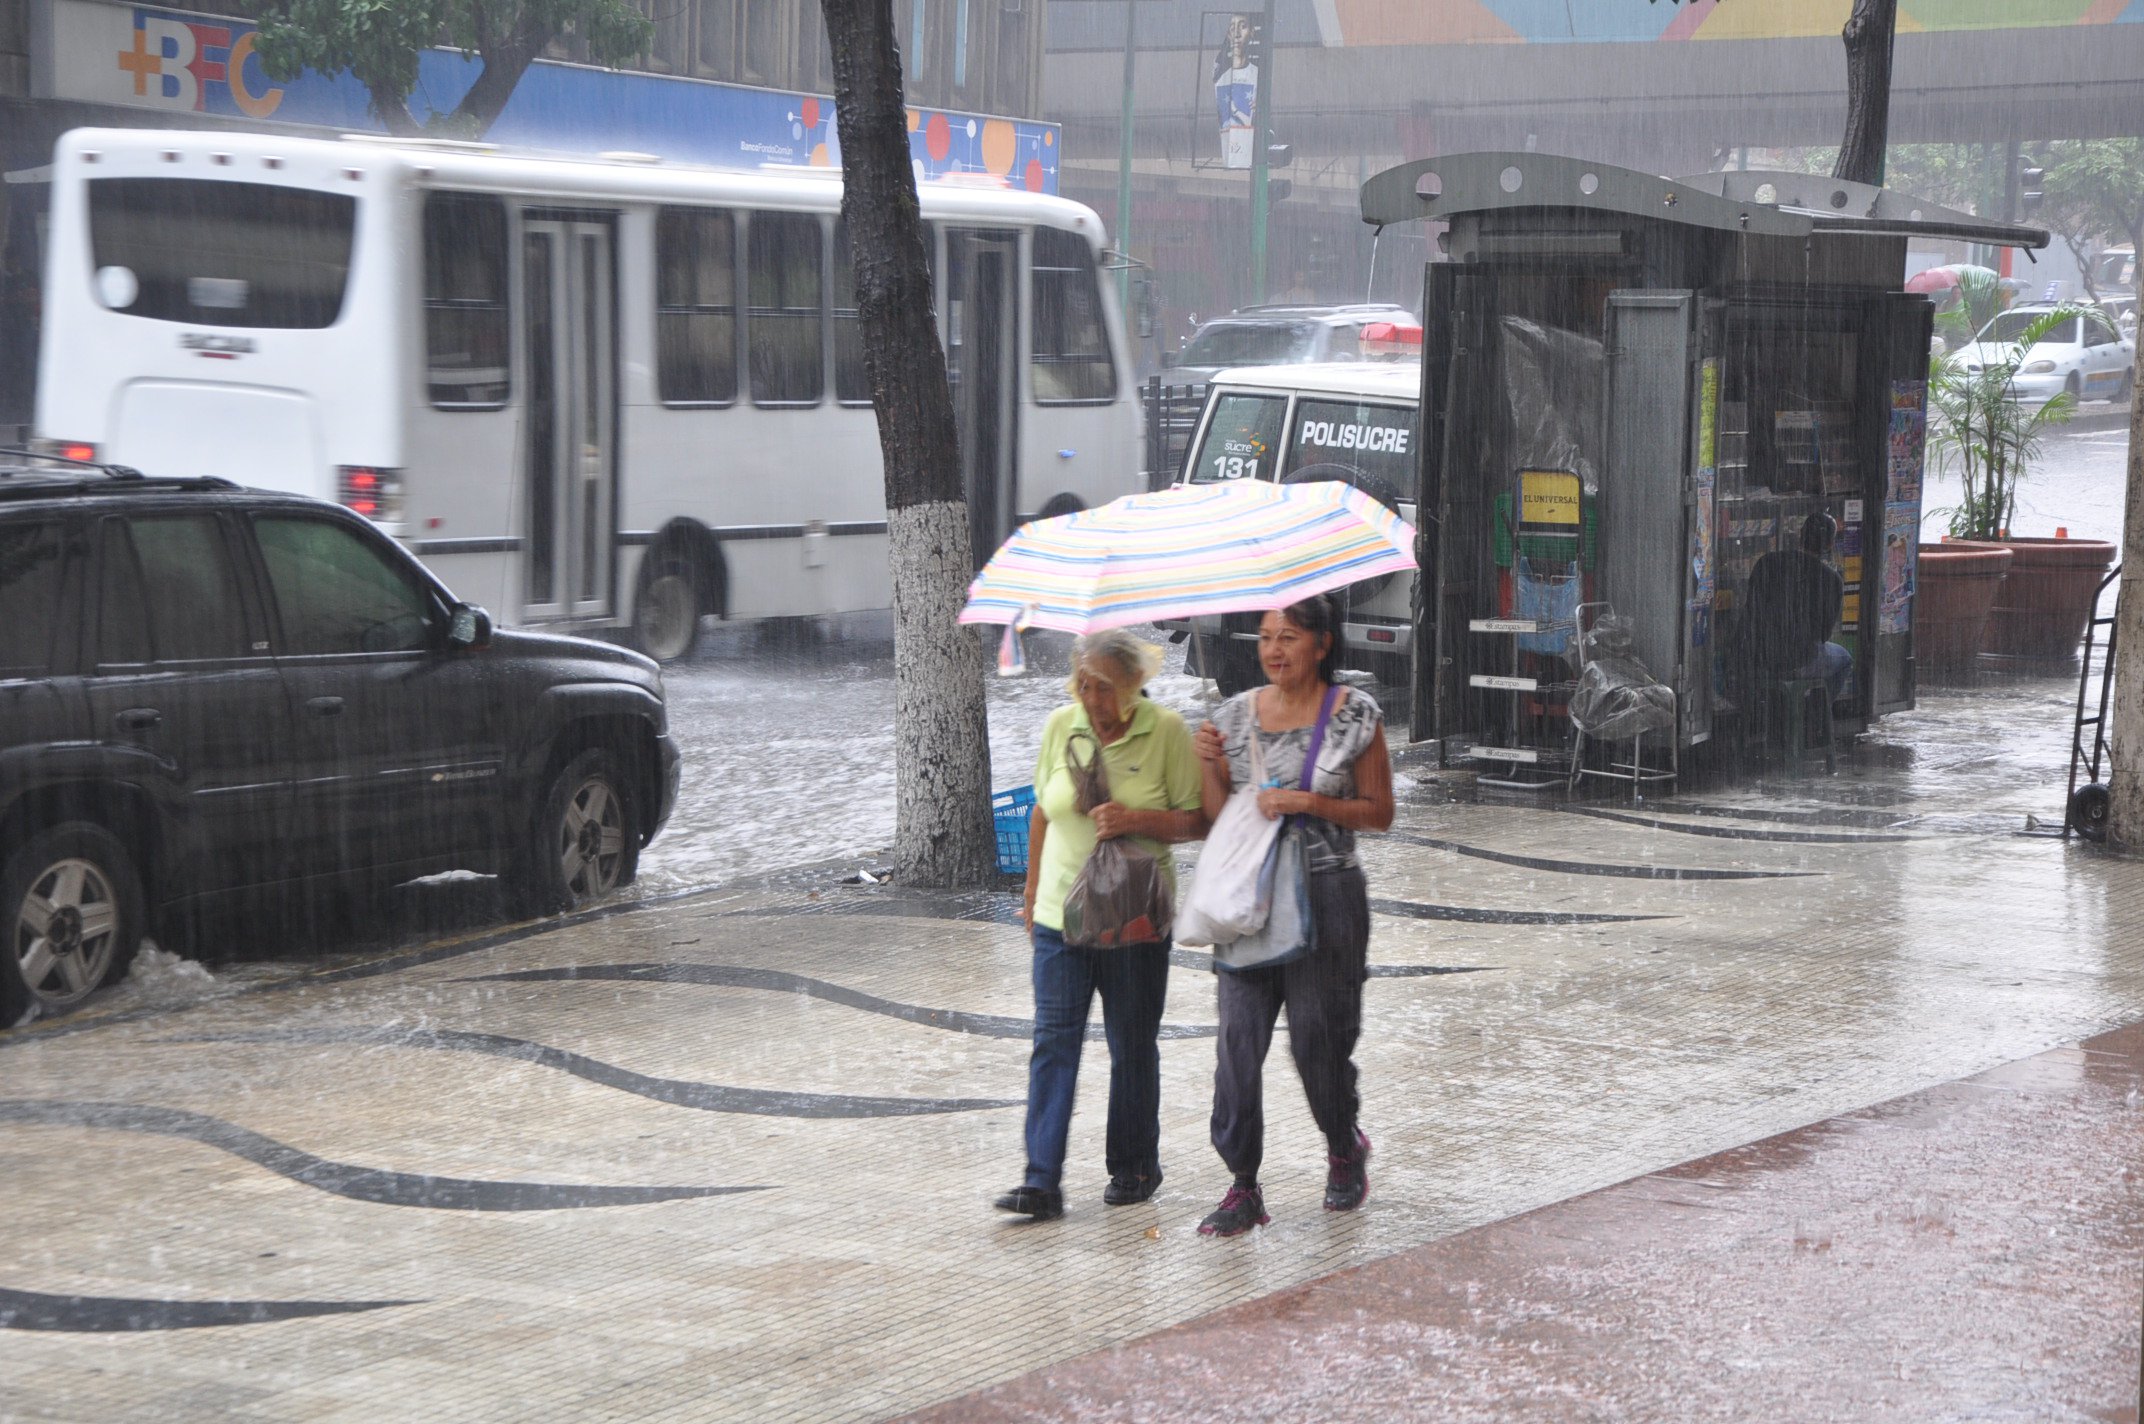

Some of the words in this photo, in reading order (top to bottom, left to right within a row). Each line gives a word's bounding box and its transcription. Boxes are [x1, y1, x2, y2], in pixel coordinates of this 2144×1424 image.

[1301, 420, 1410, 454] POLISUCRE
[1224, 442, 1253, 453] sucre
[1213, 456, 1259, 480] 131
[1523, 494, 1533, 503] EL
[1533, 494, 1578, 504] UNIVERSAL
